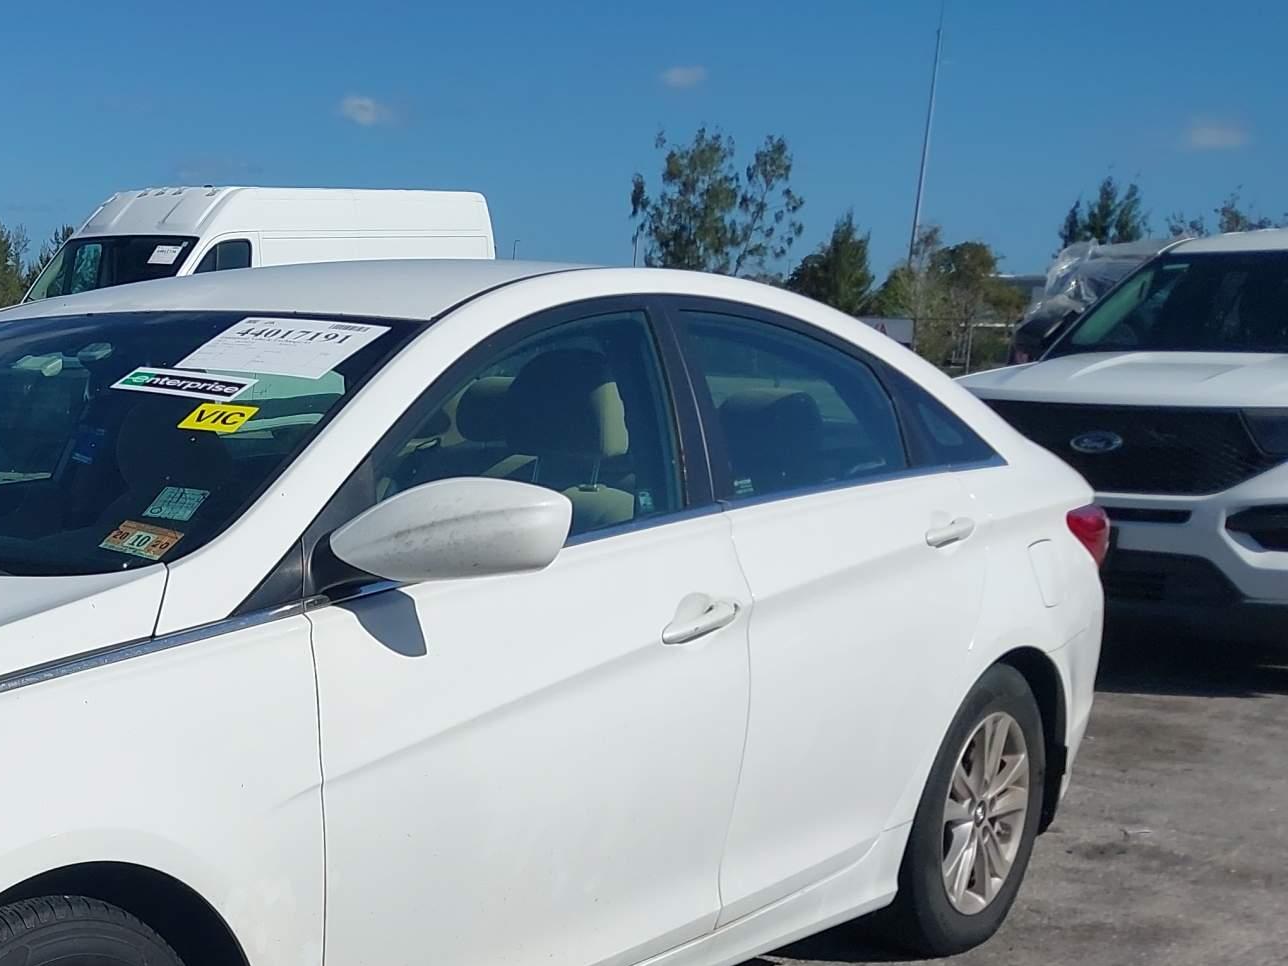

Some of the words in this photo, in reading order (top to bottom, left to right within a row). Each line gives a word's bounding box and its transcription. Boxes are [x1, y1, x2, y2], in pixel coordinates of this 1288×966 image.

[237, 327, 352, 344] 44017191
[127, 375, 240, 393] enterprise
[195, 409, 246, 427] VIC
[128, 534, 152, 548] 10
